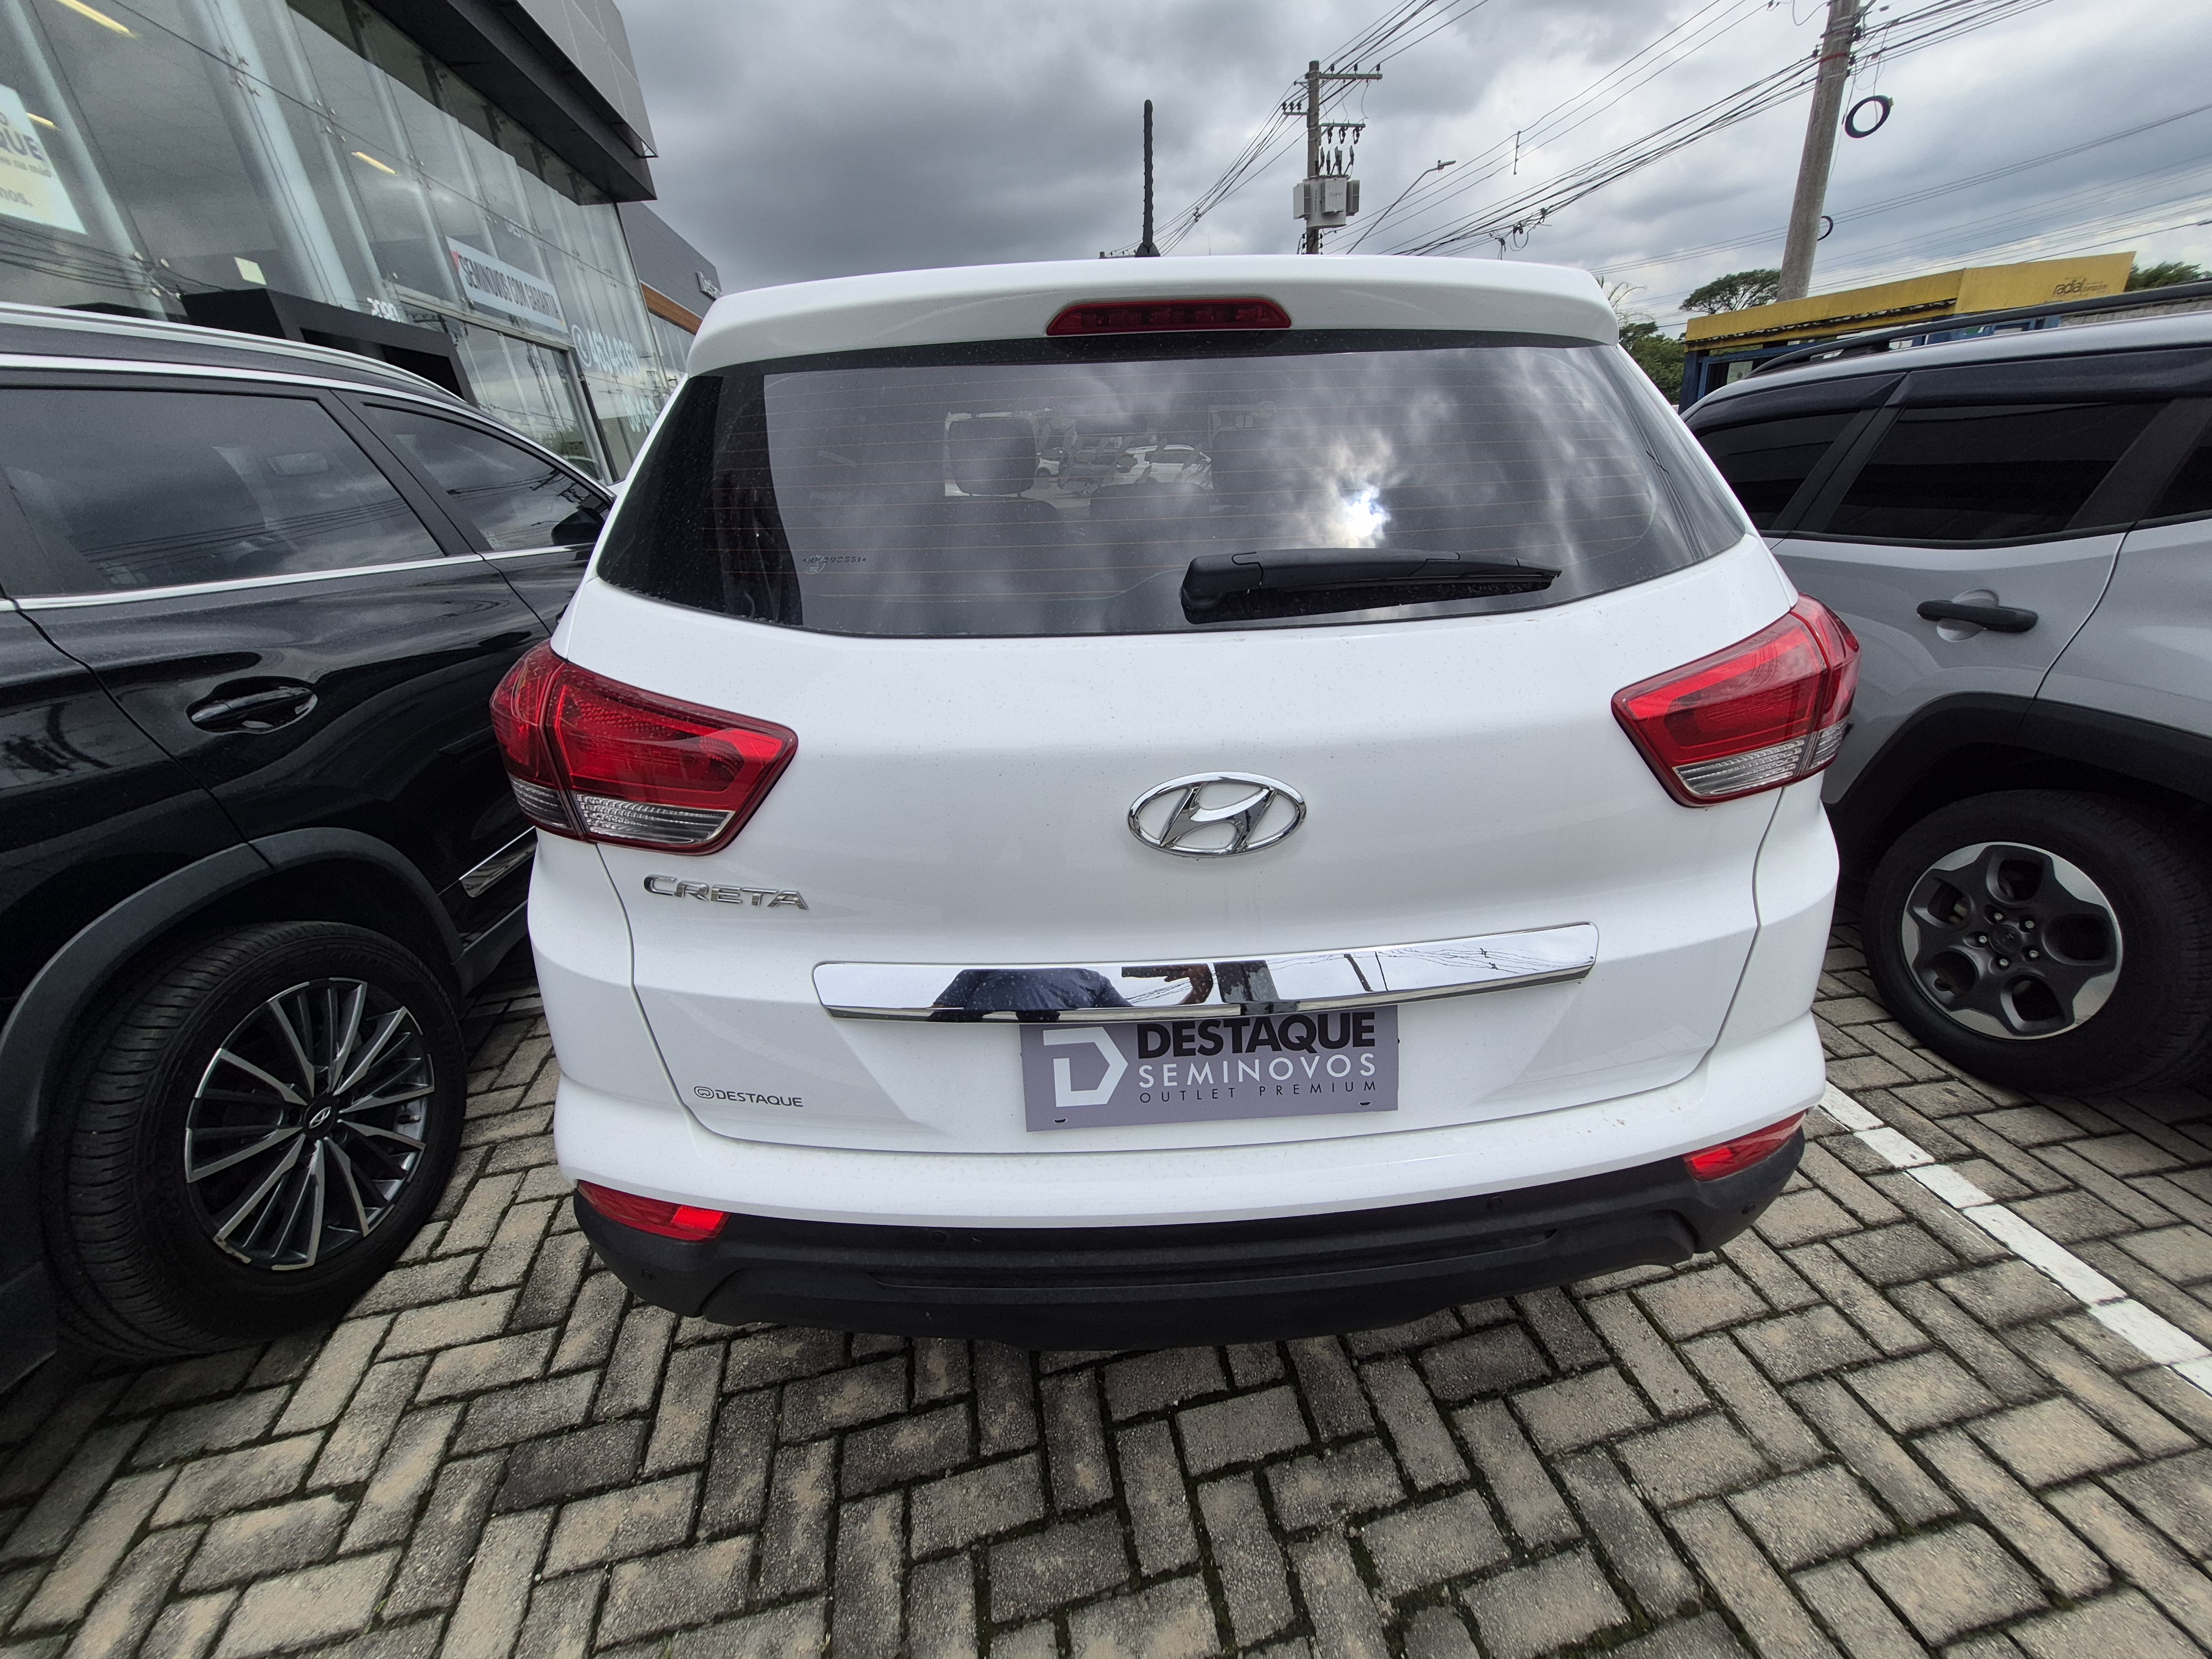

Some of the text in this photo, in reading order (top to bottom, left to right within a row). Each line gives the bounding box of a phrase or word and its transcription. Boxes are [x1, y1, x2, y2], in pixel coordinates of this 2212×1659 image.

[458, 254, 562, 321] SEMINOVOS COM GARANTIA
[644, 874, 809, 910] CRETA
[1137, 1011, 1375, 1059] DESTAQUE
[1139, 1053, 1375, 1088] SEMINOVOS
[715, 1089, 804, 1107] DESTAQUE
[1140, 1081, 1376, 1103] OUTLET PREMIUM
